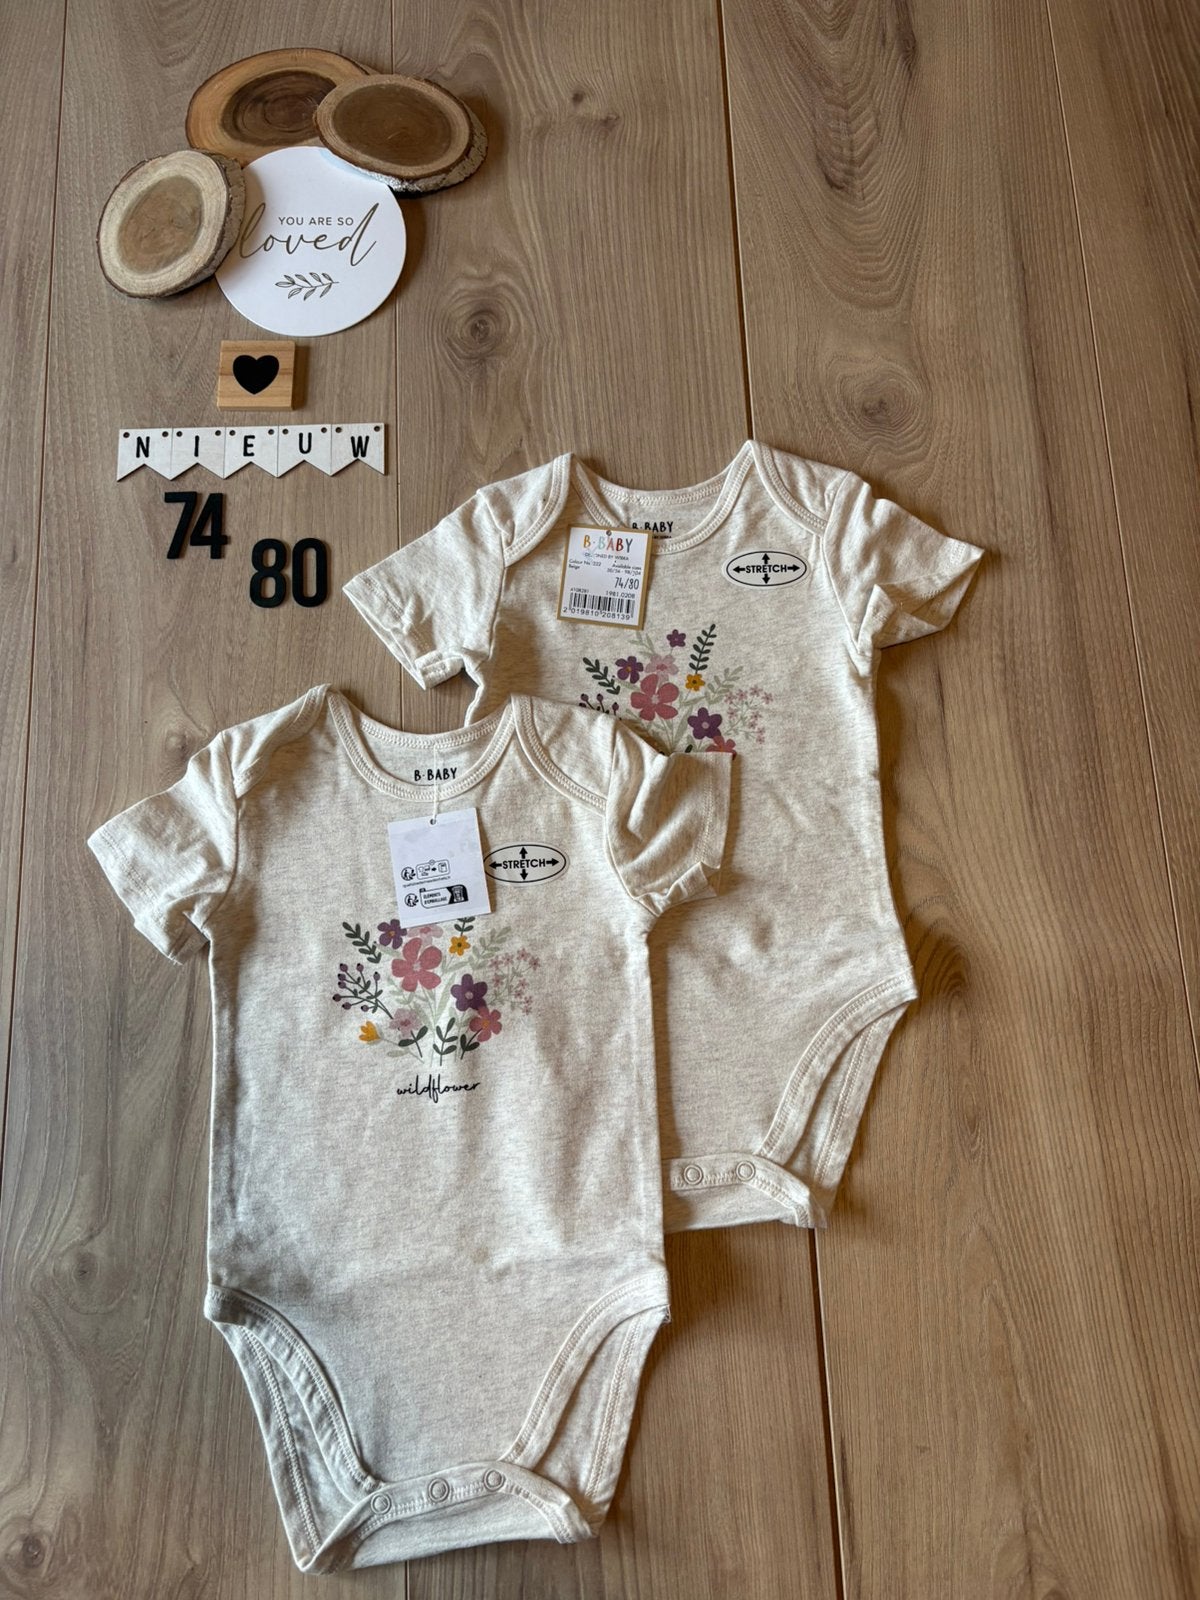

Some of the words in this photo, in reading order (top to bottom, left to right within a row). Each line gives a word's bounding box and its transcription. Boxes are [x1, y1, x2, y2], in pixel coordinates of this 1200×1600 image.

[278, 216, 304, 226] YOU
[308, 216, 333, 226] ARE
[337, 216, 354, 226] SO
[239, 202, 380, 267] loved
[164, 491, 229, 559] 74
[250, 537, 328, 608] 80
[745, 564, 788, 573] STRETCH
[614, 577, 640, 590] 74/80
[502, 859, 546, 870] STRETCH
[396, 1074, 481, 1103] wildflower
